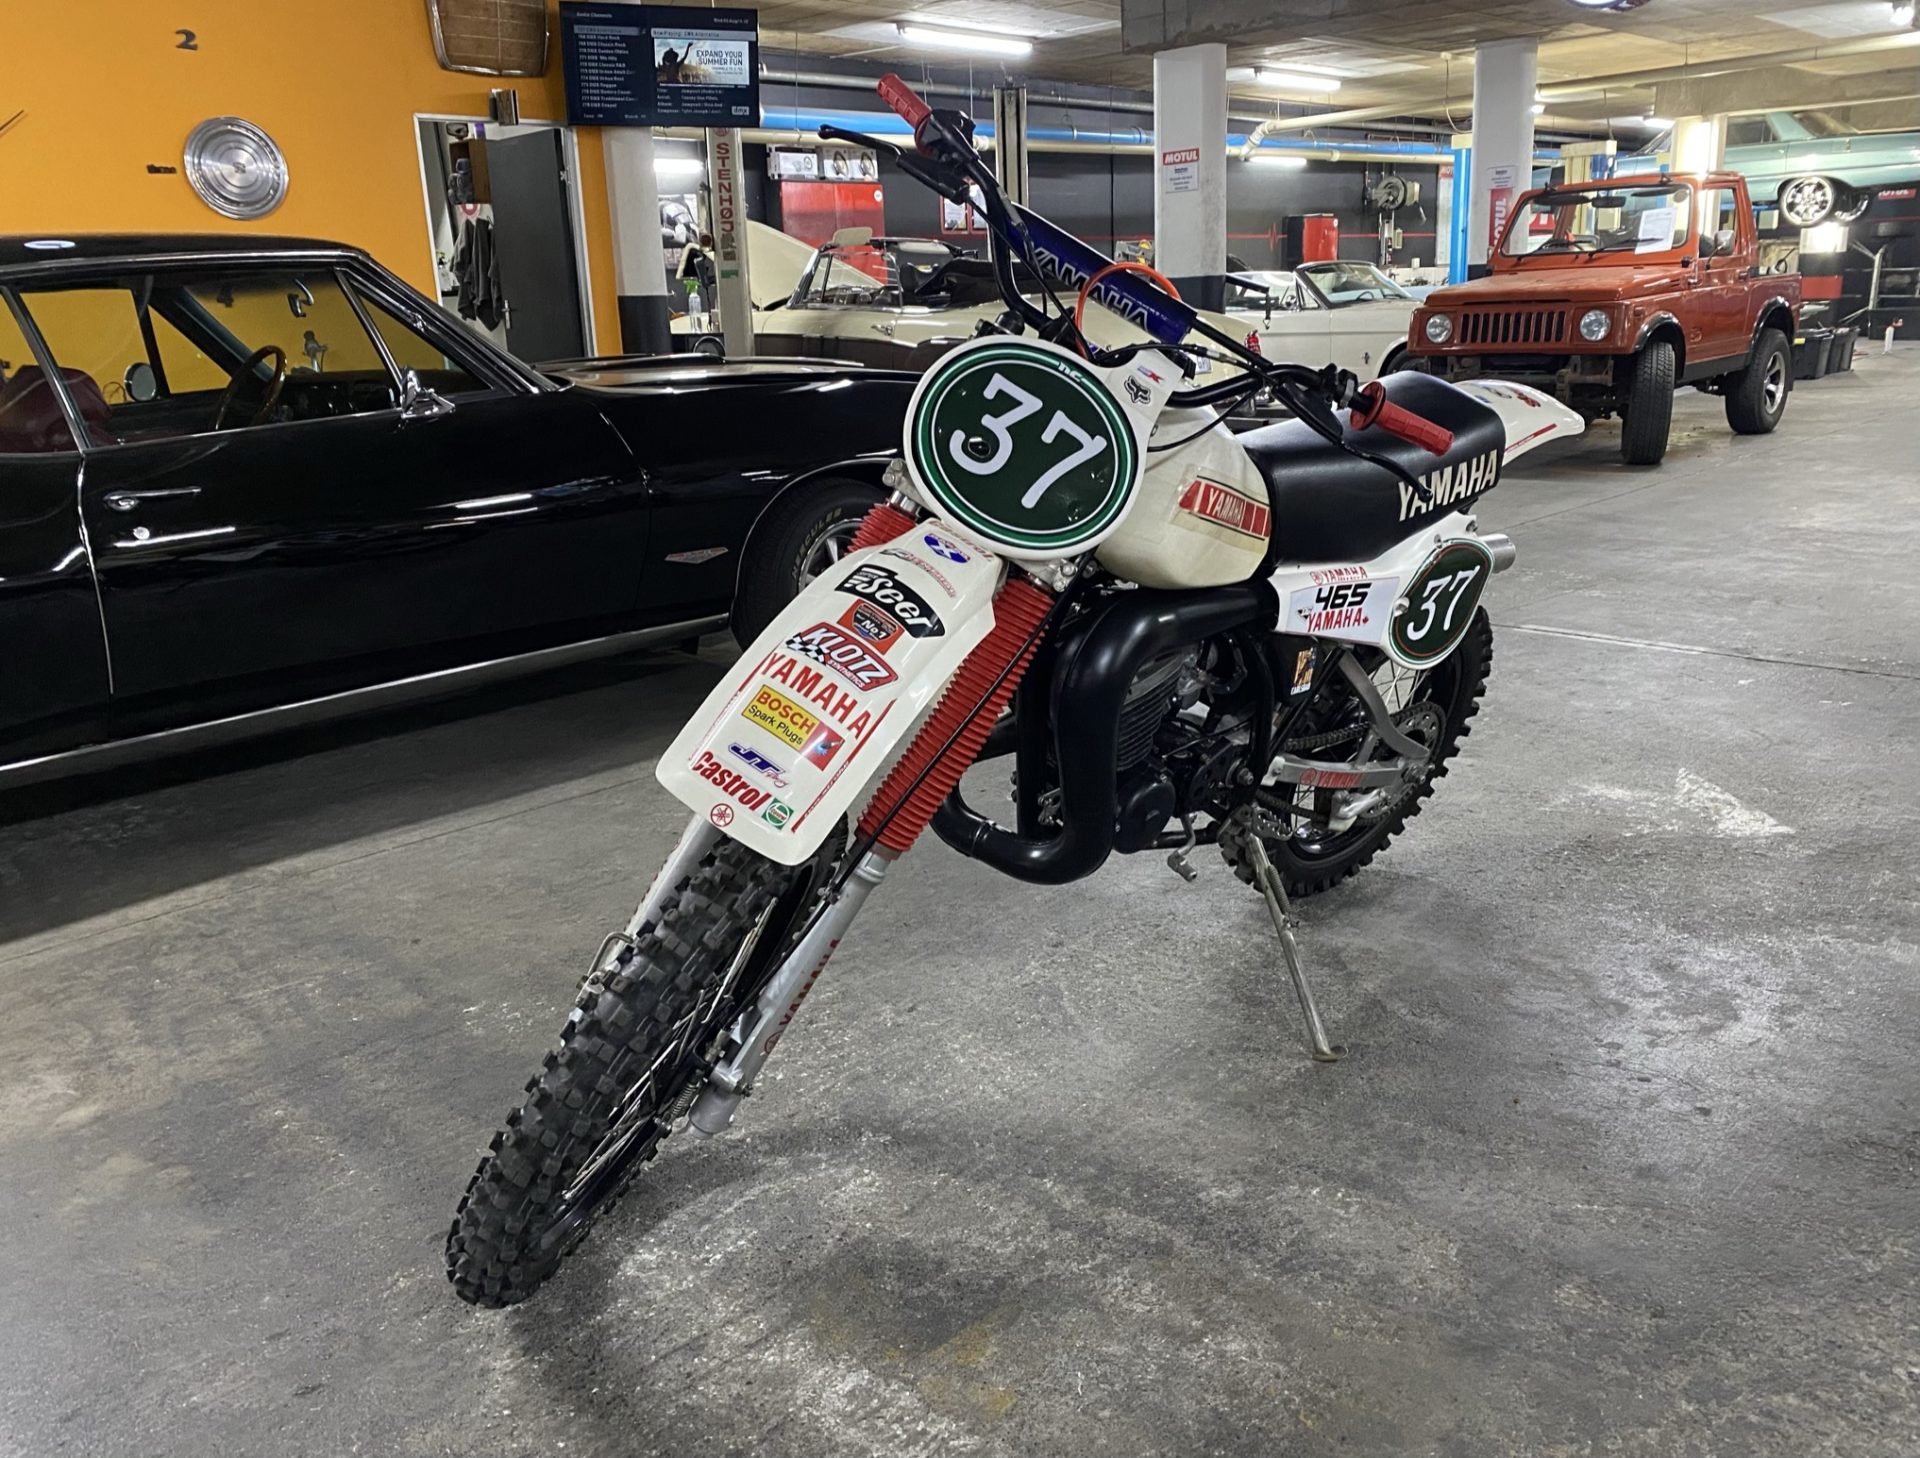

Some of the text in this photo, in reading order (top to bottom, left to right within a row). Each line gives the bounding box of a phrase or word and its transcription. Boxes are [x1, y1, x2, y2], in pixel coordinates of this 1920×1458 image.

[175, 29, 198, 50] 2
[696, 50, 723, 58] EXPAND
[698, 58, 727, 66] SUMMER
[1164, 150, 1198, 164] MOTUL
[949, 372, 1108, 510] 37
[1398, 449, 1498, 523] YAMAHA
[1315, 582, 1373, 611] 465
[1406, 564, 1482, 641] 37
[1308, 607, 1363, 633] YAMAHA
[802, 627, 891, 685] KLOTZ
[827, 659, 866, 689] SYNTHETICS
[756, 690, 816, 735] BOSCH
[761, 652, 872, 740] YAMAHA
[748, 704, 804, 746] Spark Plugs
[692, 751, 773, 812] Castrol
